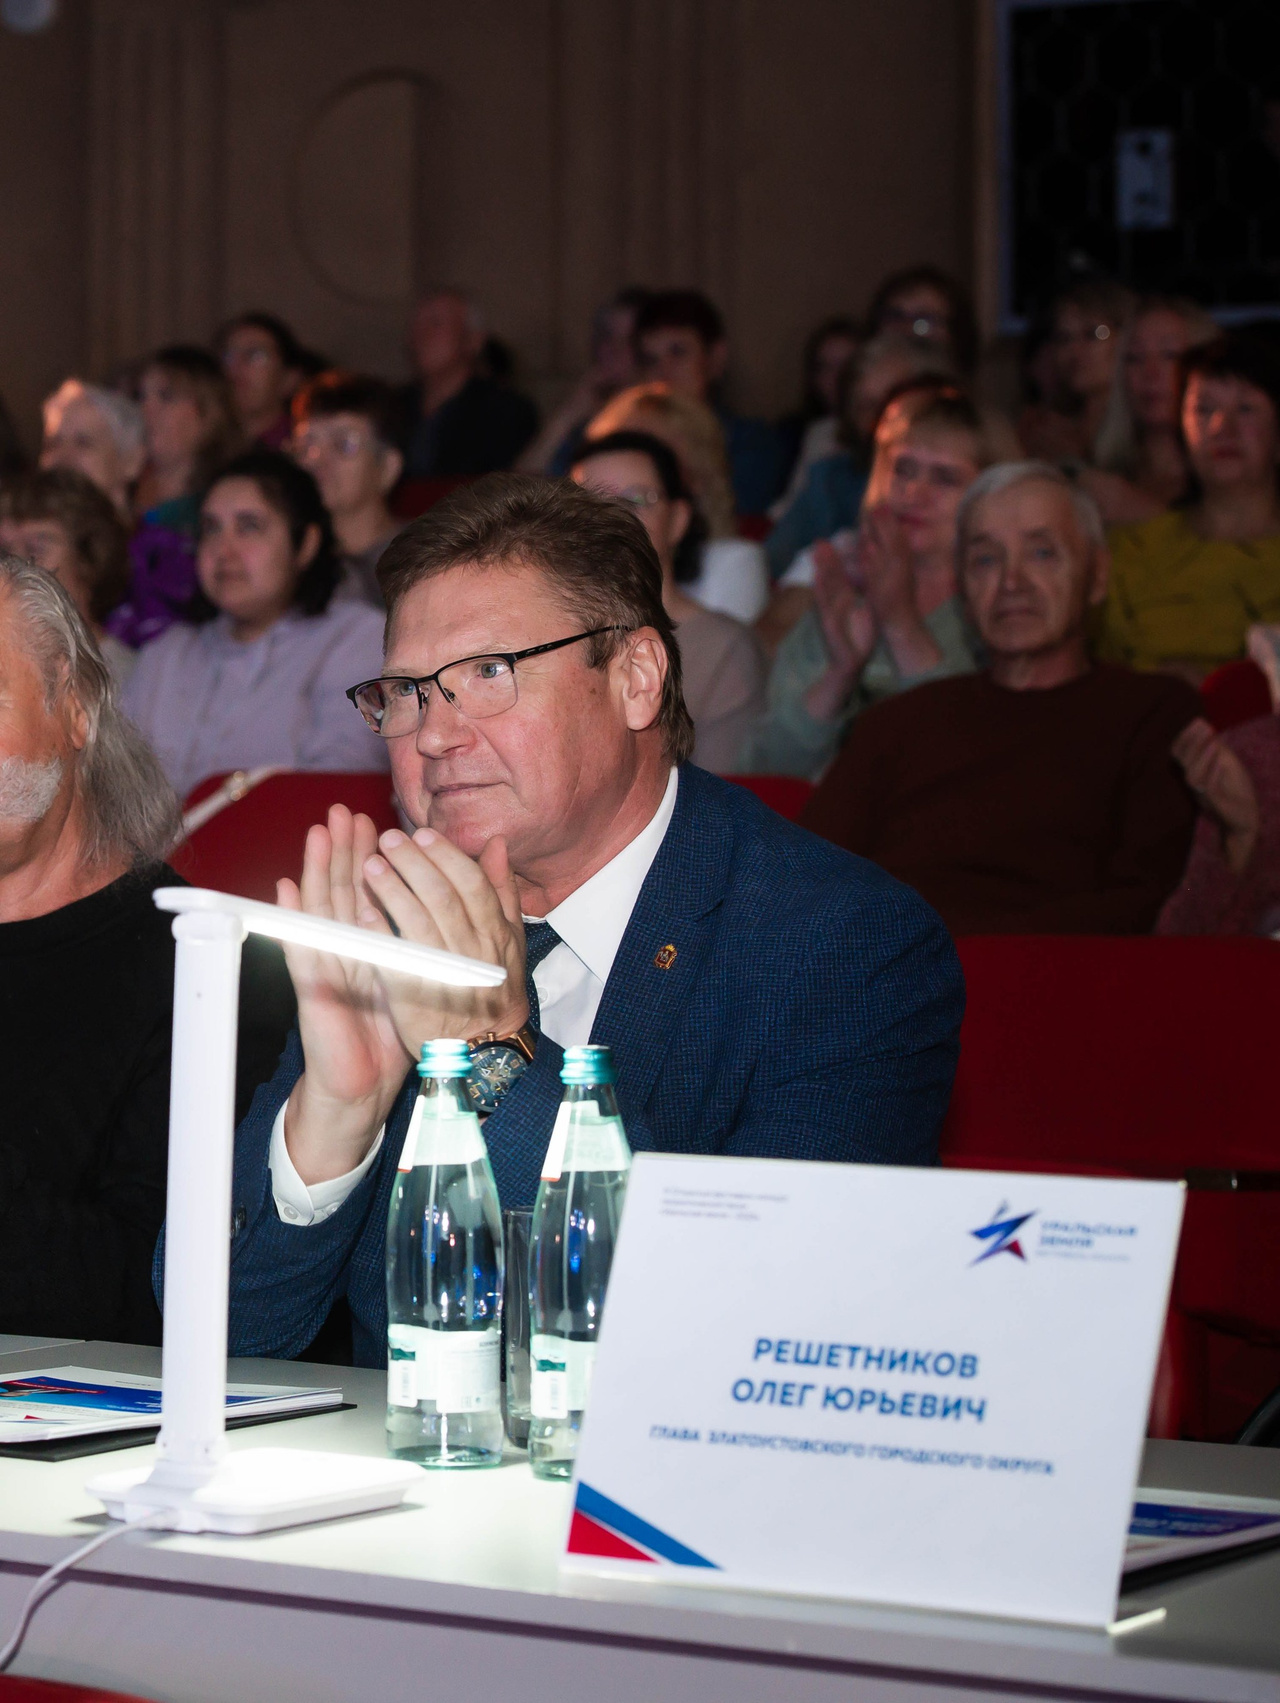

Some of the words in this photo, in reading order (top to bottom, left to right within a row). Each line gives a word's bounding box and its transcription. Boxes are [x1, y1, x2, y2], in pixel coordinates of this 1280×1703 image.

[753, 1337, 979, 1378] РЕШЕТНИКОВ
[731, 1377, 816, 1407] ОЛЕГ
[822, 1386, 989, 1424] ЮРЬЕВИЧ
[649, 1424, 701, 1443] ГЛАВА
[707, 1429, 867, 1460] ЗЛАТОУСТОВСКОГО
[867, 1441, 984, 1470] ГОРОДСКОГО
[987, 1453, 1055, 1477] ОКРУГА
